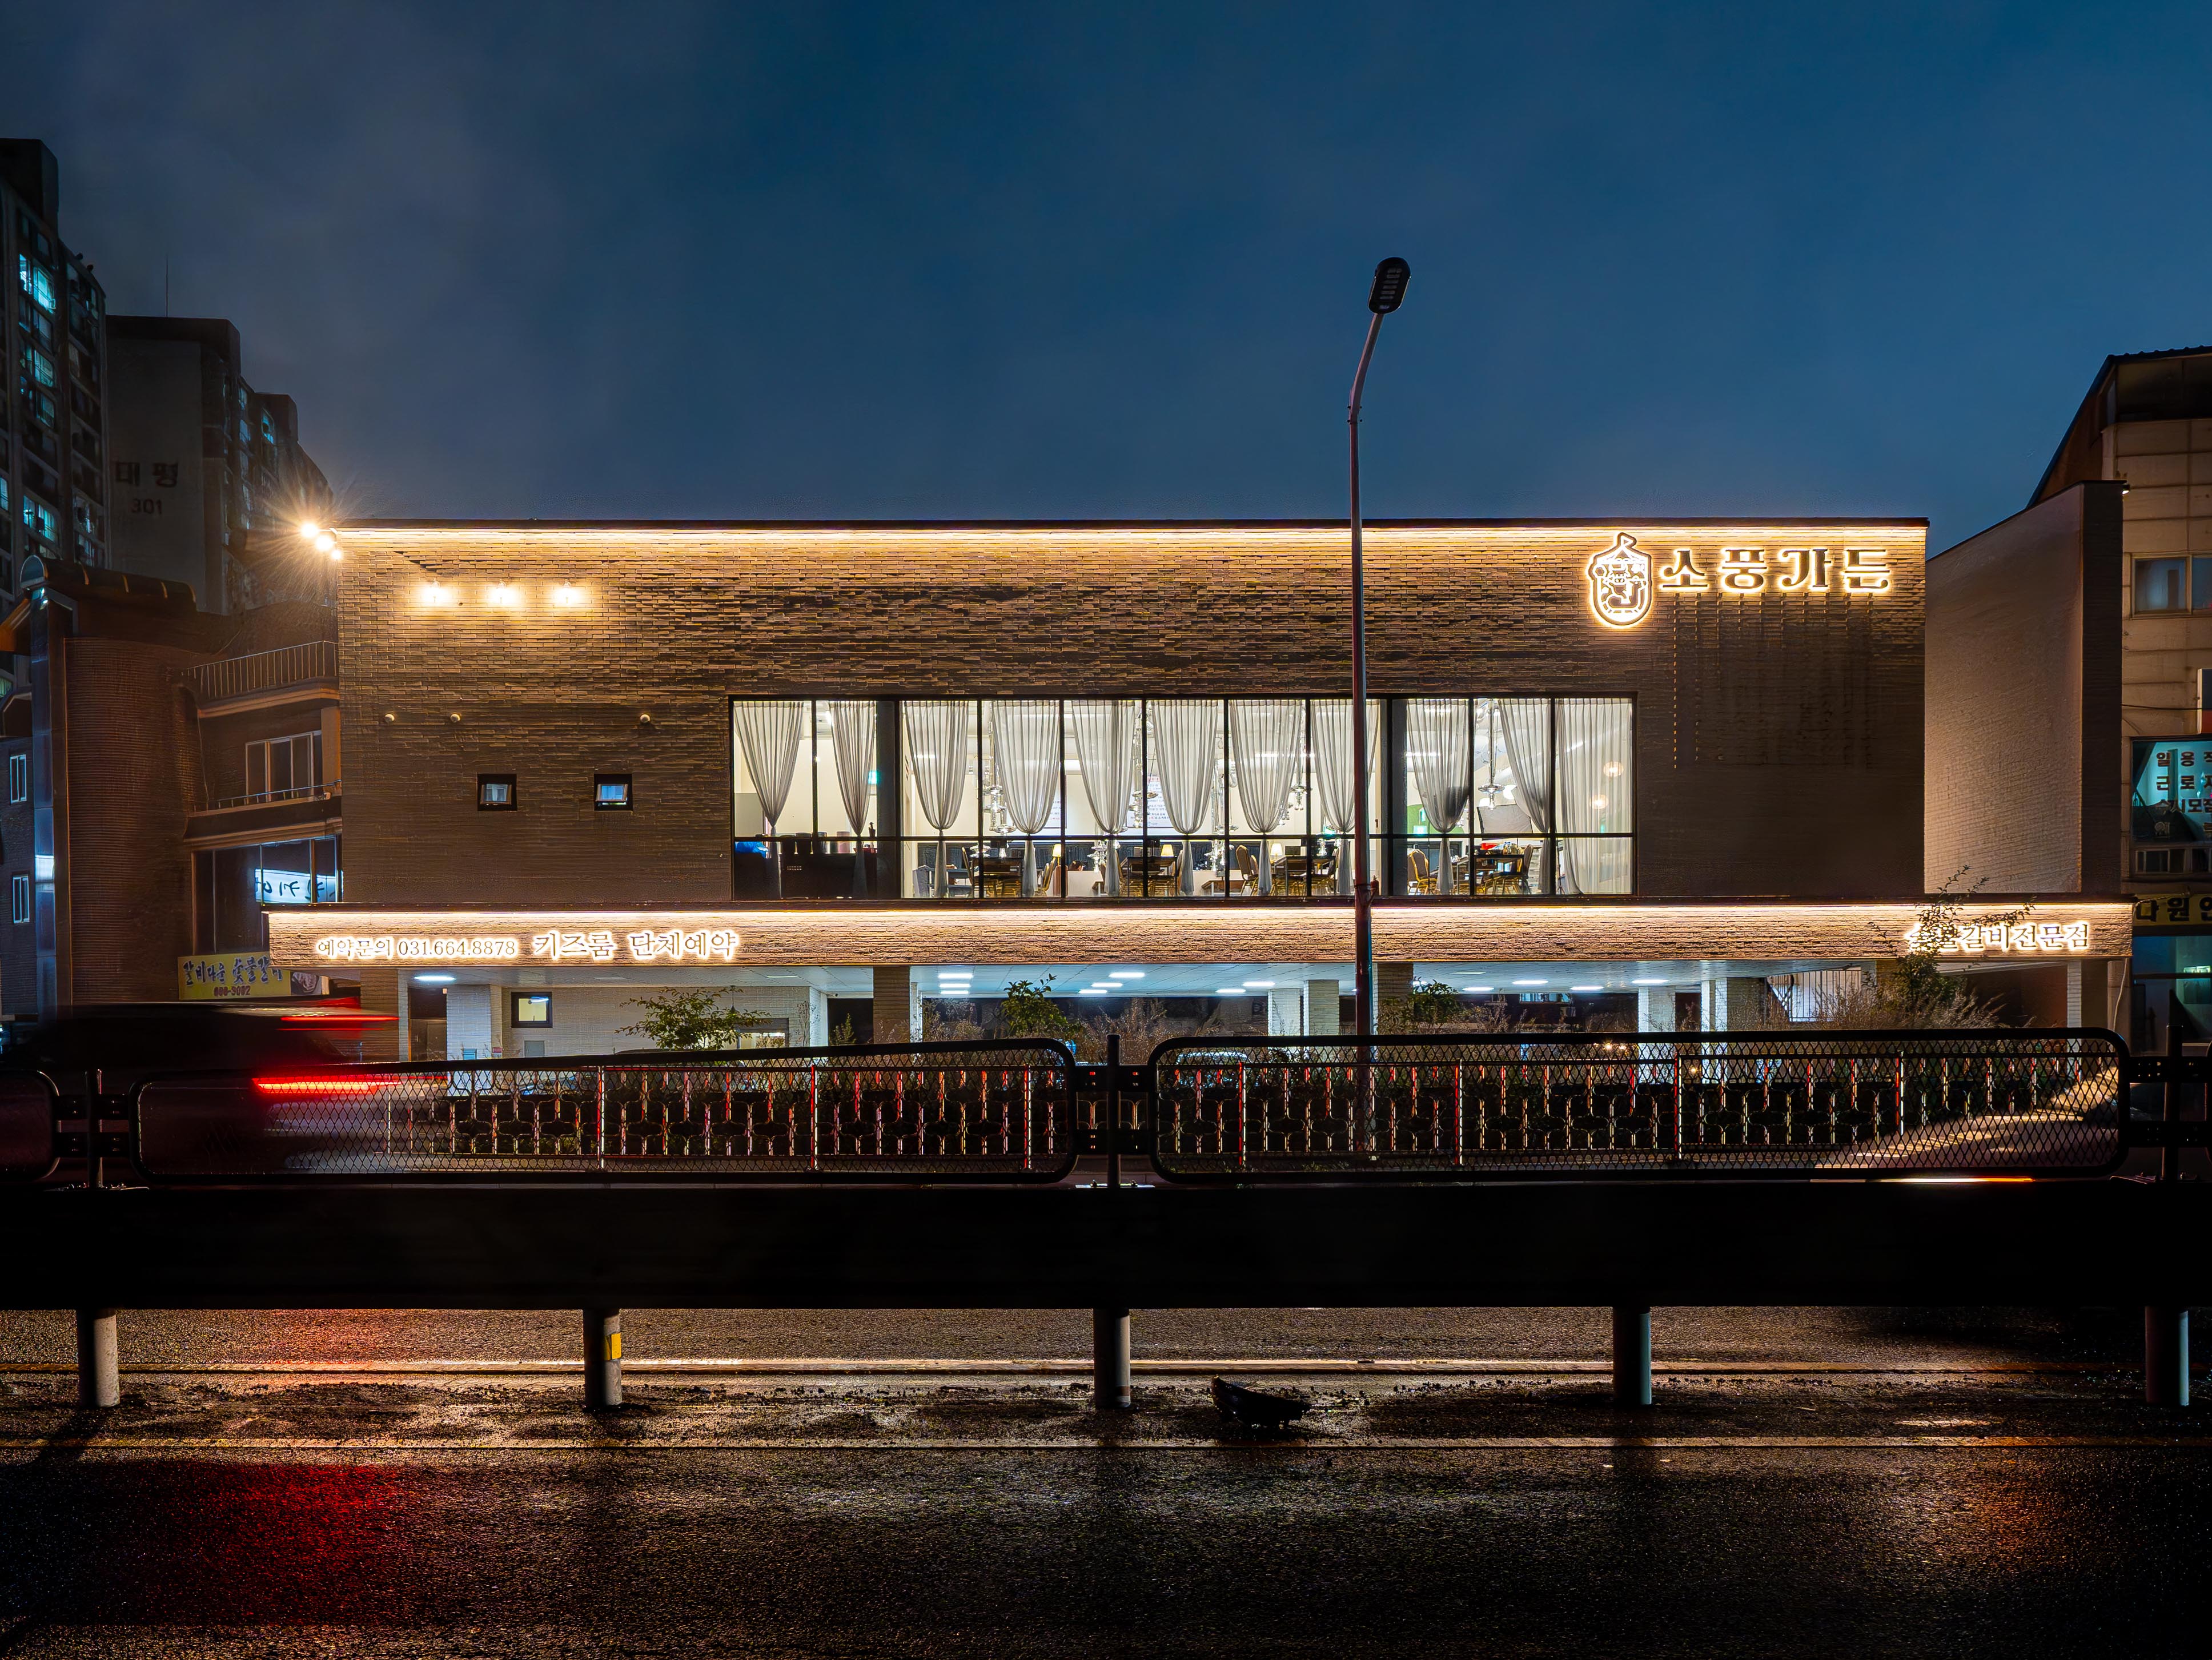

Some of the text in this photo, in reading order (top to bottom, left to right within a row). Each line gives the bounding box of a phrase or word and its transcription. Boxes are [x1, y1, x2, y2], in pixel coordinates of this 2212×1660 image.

[1663, 549, 1890, 589] 소풍가든
[318, 932, 736, 957] 예약문의 031.664.8878 키즈룸 단체예약
